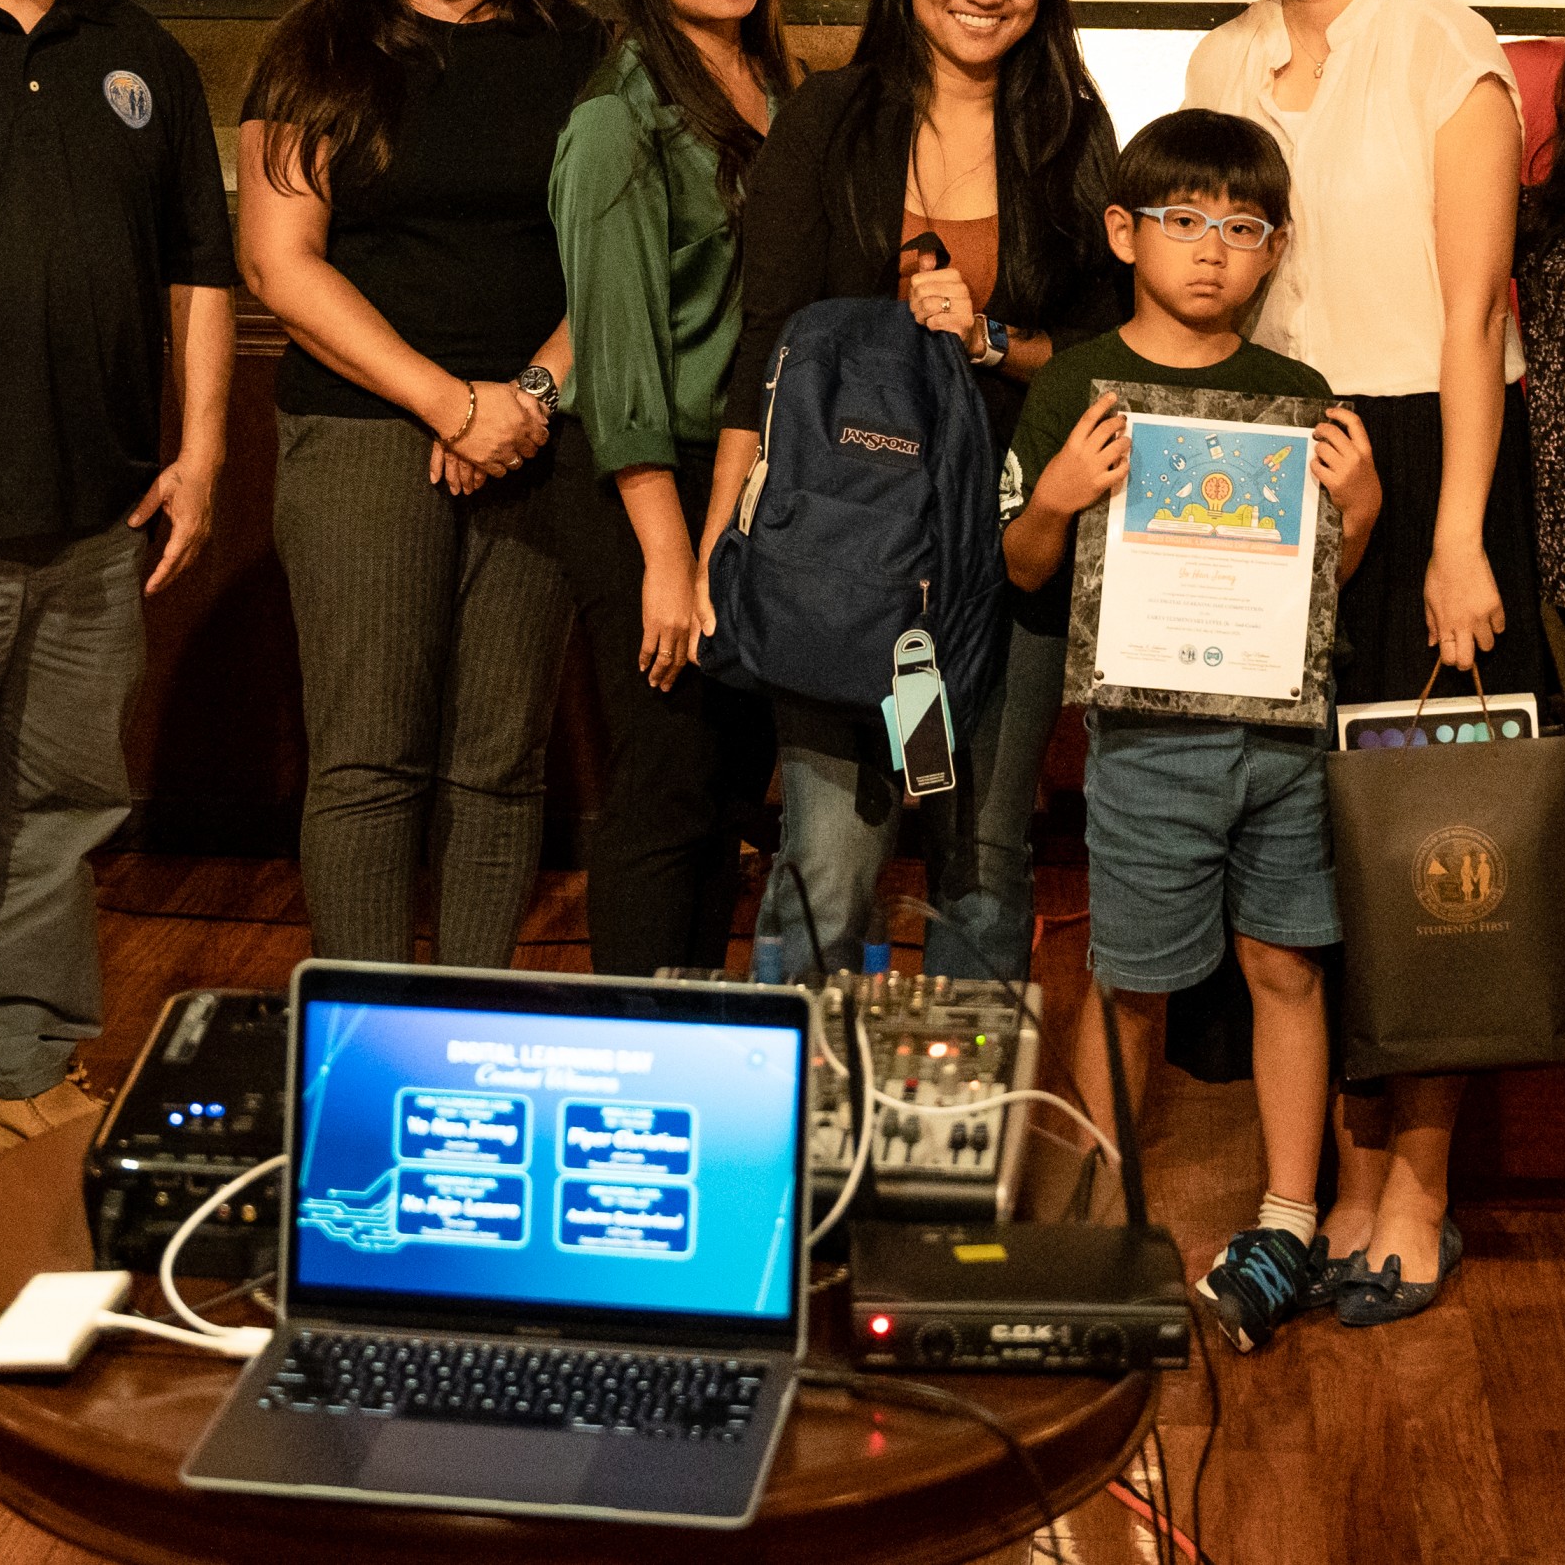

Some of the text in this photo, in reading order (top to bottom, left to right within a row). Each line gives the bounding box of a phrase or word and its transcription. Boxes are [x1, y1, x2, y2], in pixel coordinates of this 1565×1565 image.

[839, 427, 920, 455] JANSPORT
[1415, 920, 1511, 936] STUDENTS FIRST
